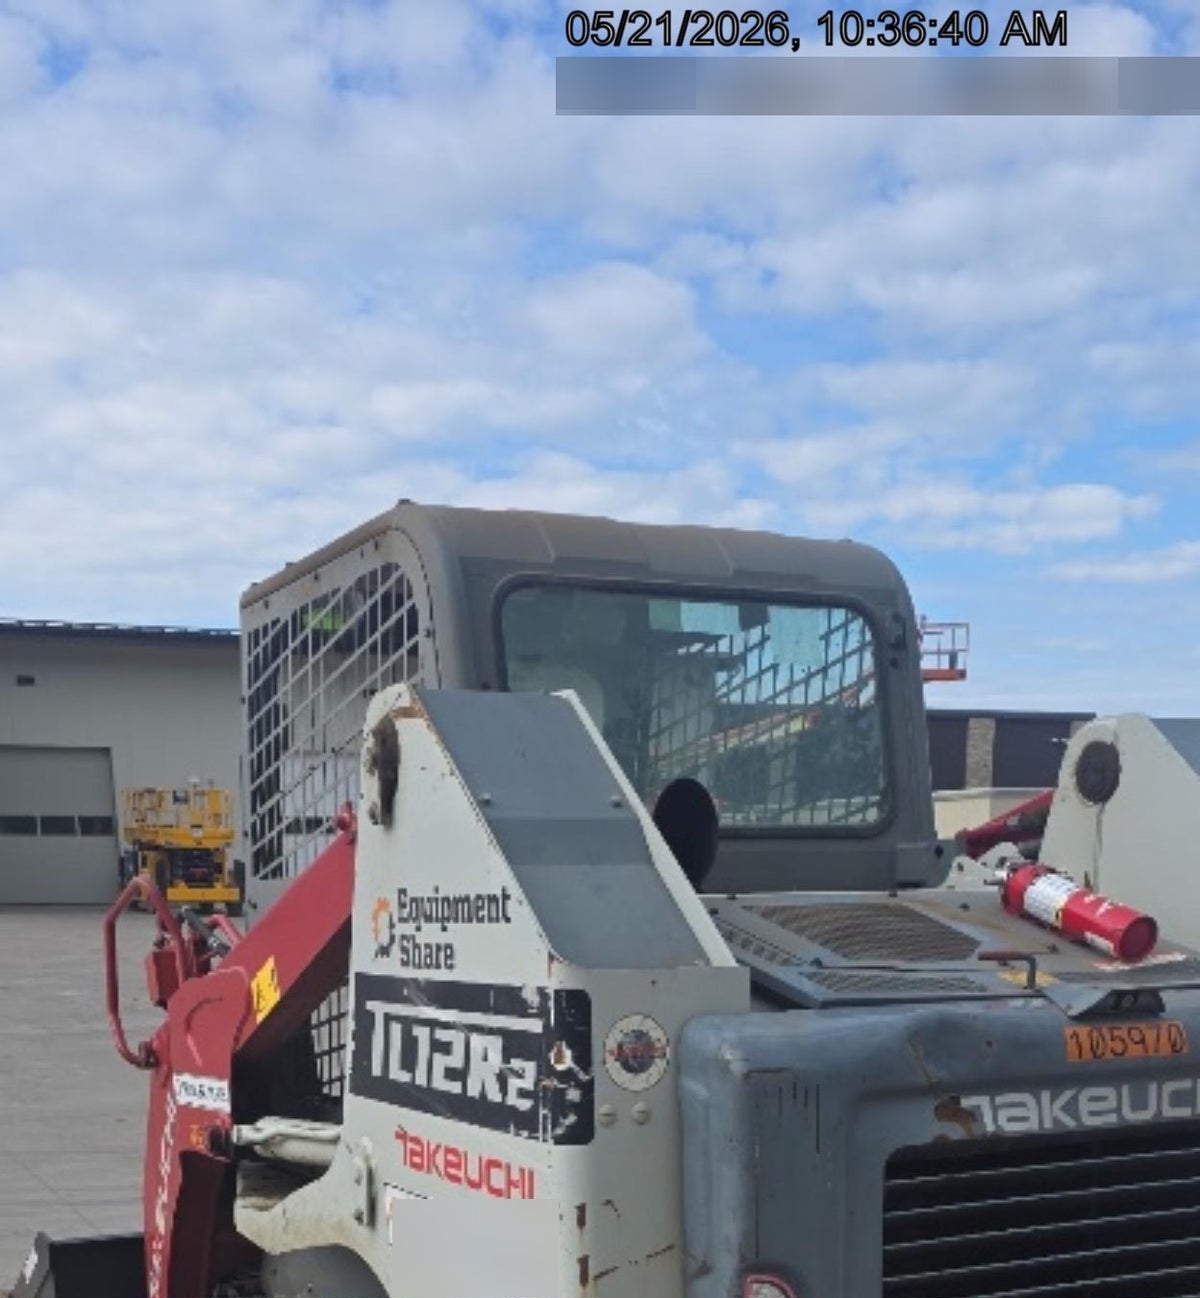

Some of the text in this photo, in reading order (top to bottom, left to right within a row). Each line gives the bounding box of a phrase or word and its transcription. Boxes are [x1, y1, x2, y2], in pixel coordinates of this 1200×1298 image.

[397, 887, 512, 932] Equipment
[398, 934, 457, 970] Share
[960, 1077, 1200, 1132] TAKEUC
